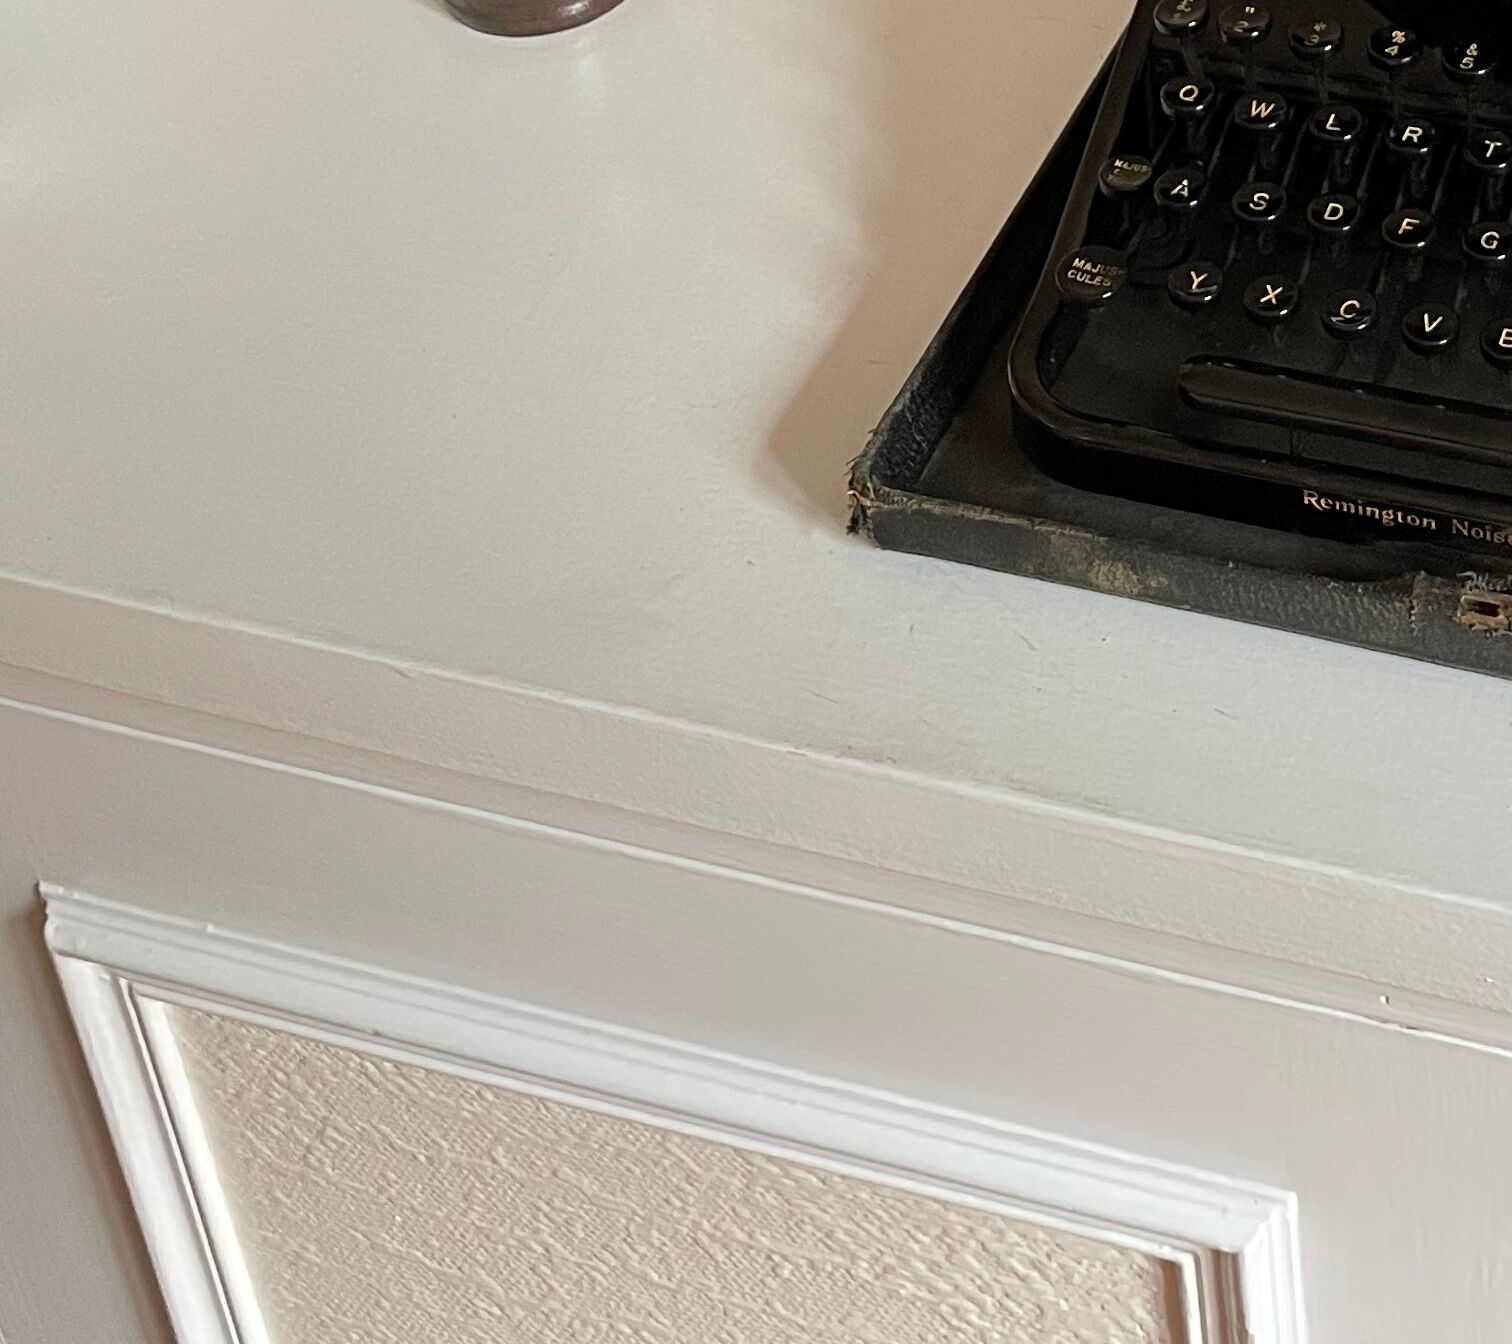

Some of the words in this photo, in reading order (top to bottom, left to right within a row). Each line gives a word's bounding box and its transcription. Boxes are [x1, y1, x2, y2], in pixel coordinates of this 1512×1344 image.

[1384, 45, 1400, 57] 4
[1459, 56, 1475, 70] 5
[1178, 84, 1200, 102] Q
[1248, 98, 1277, 119] W
[1401, 125, 1424, 144] R
[1484, 139, 1503, 158] T
[1169, 178, 1189, 199] A
[1248, 192, 1270, 212] S
[1323, 202, 1344, 221] D
[1397, 217, 1421, 235] F
[1479, 231, 1501, 250] G
[1189, 269, 1209, 290] Y
[1259, 284, 1283, 305] X
[1339, 298, 1361, 318] C
[1423, 312, 1444, 333] V
[1302, 490, 1437, 531] Remington
